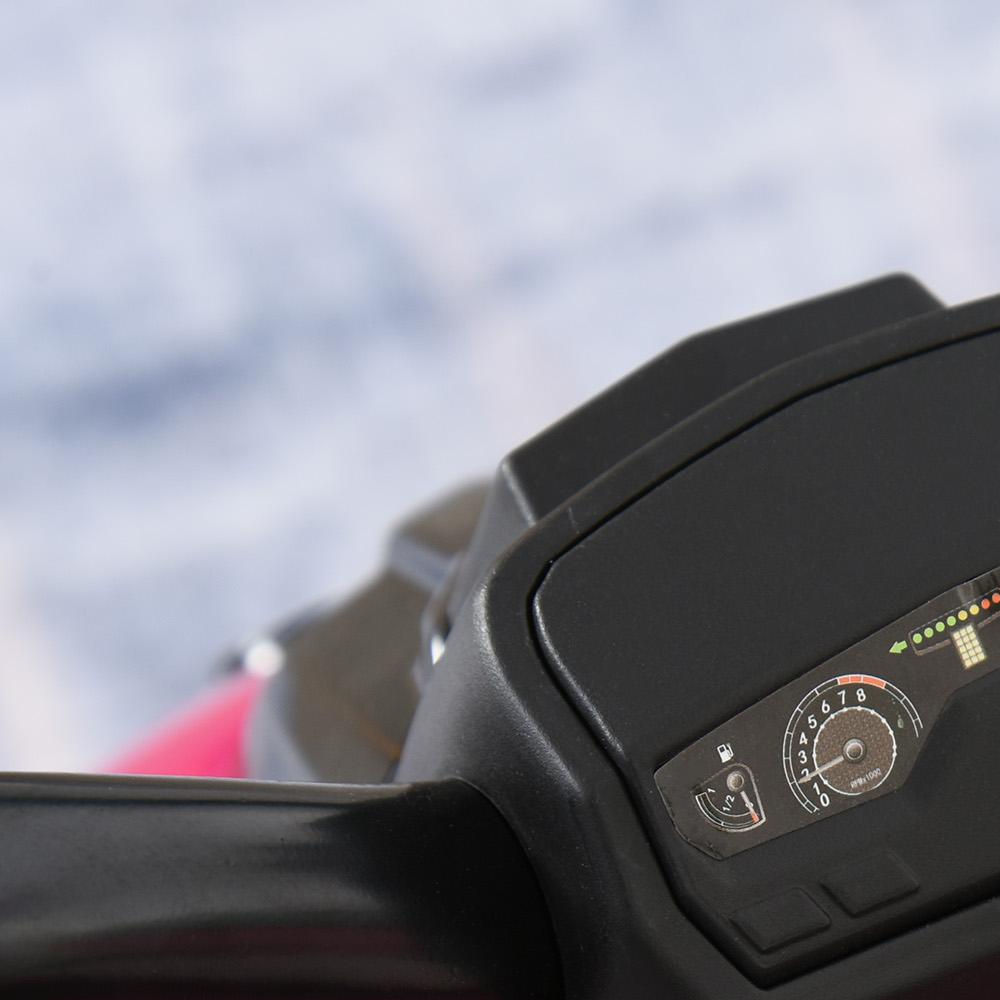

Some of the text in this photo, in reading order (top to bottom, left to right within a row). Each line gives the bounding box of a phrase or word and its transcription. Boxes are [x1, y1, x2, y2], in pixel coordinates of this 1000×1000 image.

[836, 689, 847, 705] 7
[855, 688, 866, 702] 8
[821, 699, 831, 714] 6
[807, 714, 817, 729] 5
[799, 731, 808, 745] 4
[798, 750, 807, 764] 3
[812, 782, 821, 796] 1
[722, 794, 735, 812] 1/2
[819, 792, 830, 807] 0
